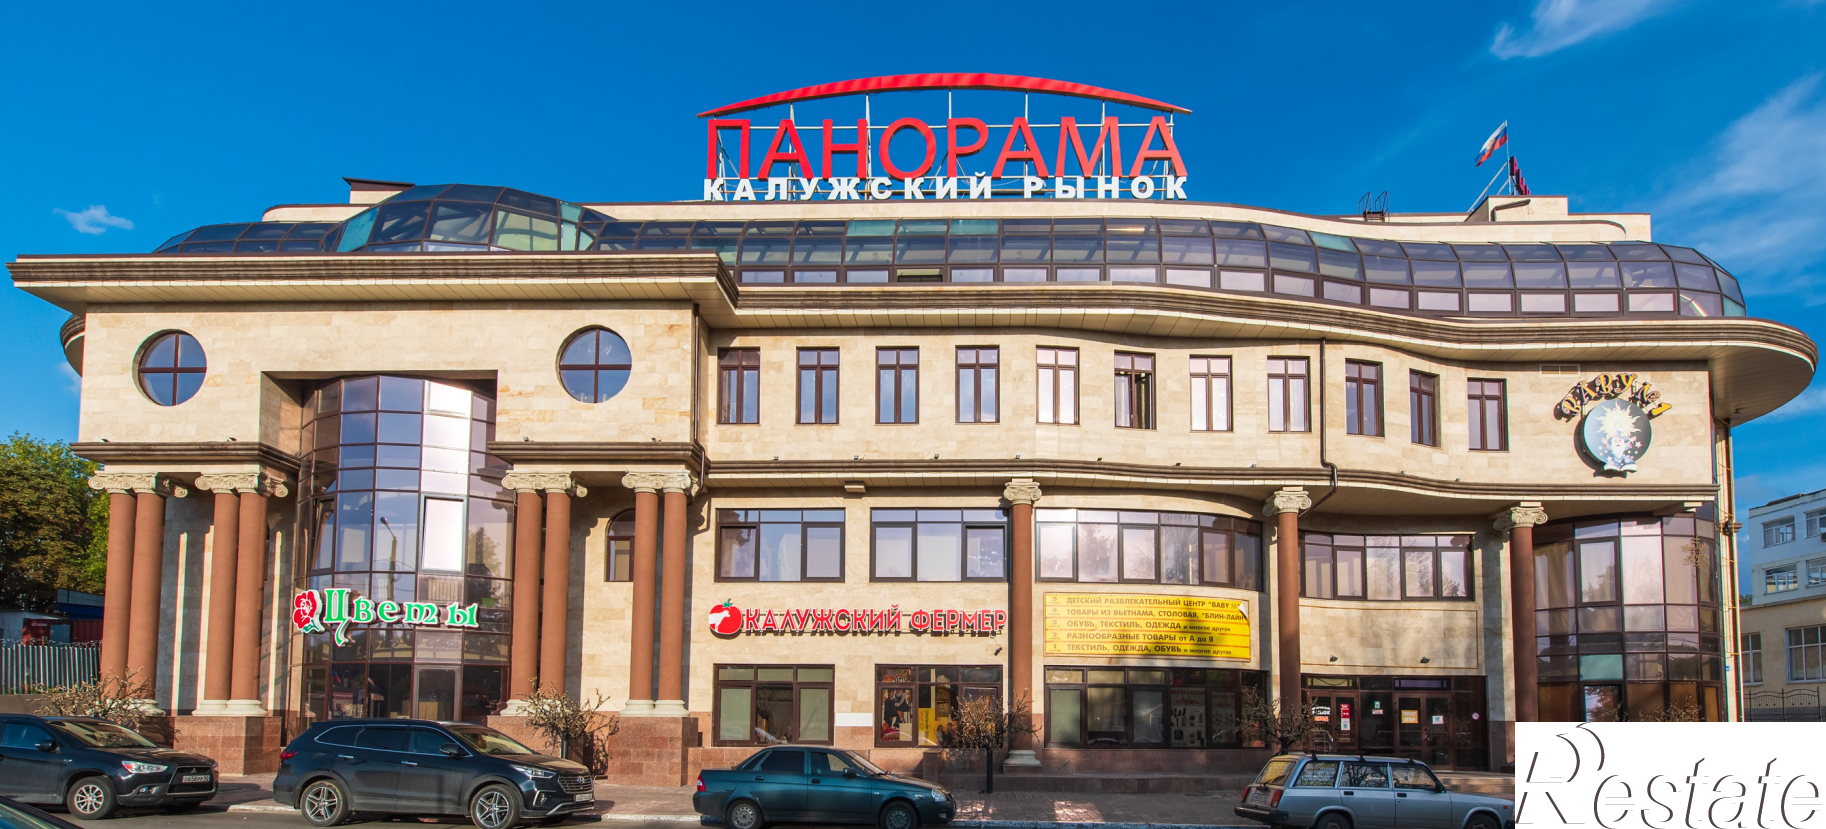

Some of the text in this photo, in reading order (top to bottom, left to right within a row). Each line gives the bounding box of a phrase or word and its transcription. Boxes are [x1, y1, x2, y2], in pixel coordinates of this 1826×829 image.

[707, 116, 1188, 180] ПАНОРАМА
[703, 171, 1189, 201] КАЛУЖСКИЙ РЫНОК
[1560, 372, 1638, 416] BABY
[1066, 596, 1102, 605] ДЕТСКИЙ
[1104, 597, 1181, 607] РАЗВЛЕКАТЕЛЬНЫЙ
[1183, 599, 1206, 608] ЦЕНТР
[322, 587, 480, 648] Цветы
[745, 603, 1009, 632] КАЛУЖСКИЙ ФЕРМЕР
[1066, 608, 1099, 616] ТОВАРЫ
[1113, 609, 1156, 618] ВЬЕТНАМА,
[1158, 610, 1199, 620] СТОЛОВАЯ,
[1066, 620, 1098, 629] ОБУВЬ,
[1100, 620, 1143, 629] ТЕКСТИЛЬ,
[1145, 621, 1182, 630] ОДЕЖДА
[1066, 632, 1140, 640] РАЗНООБРАЗНЫЕ
[1143, 633, 1176, 641] ТОВАРЫ
[1066, 643, 1110, 652] ТЕКСТИЛЬ,
[1112, 644, 1152, 653] ОДЕЖДА,
[1154, 645, 1182, 653] ОБУВЬ
